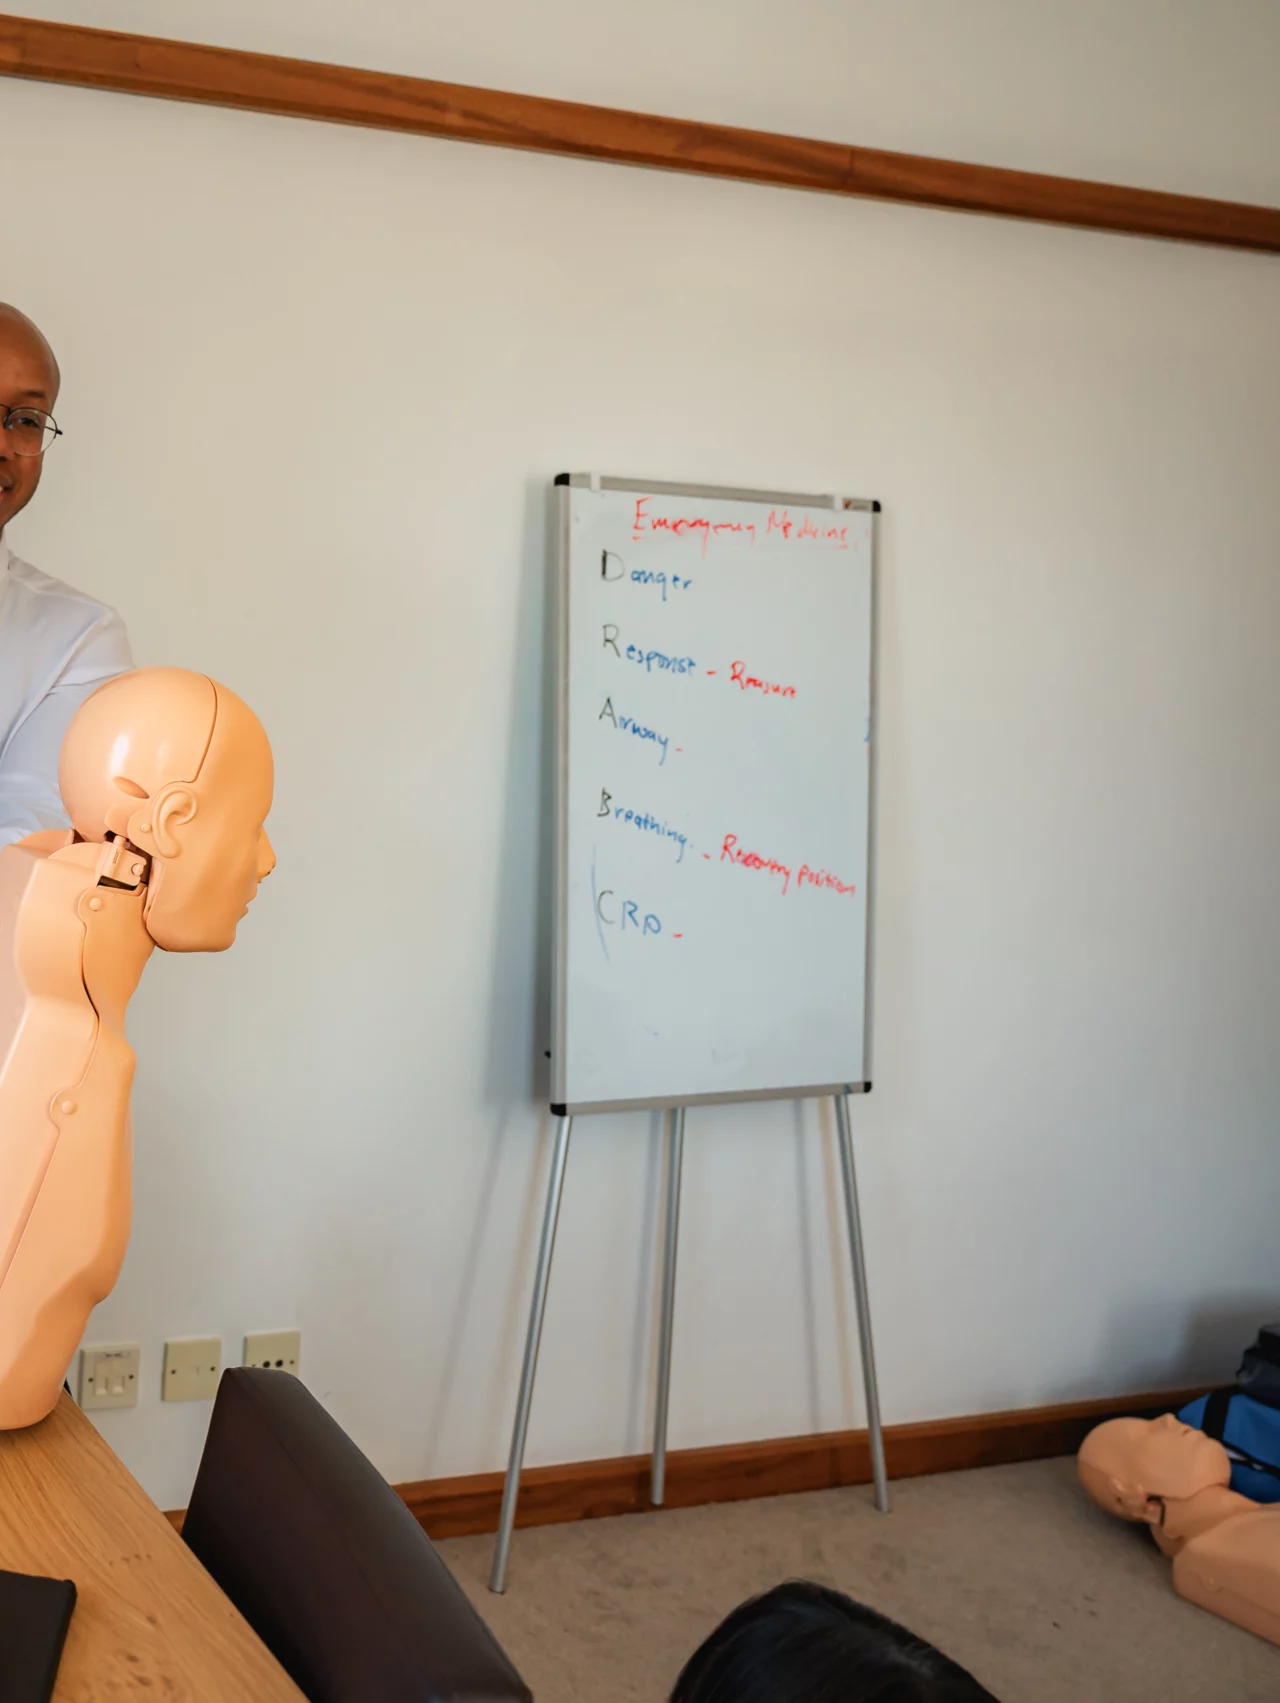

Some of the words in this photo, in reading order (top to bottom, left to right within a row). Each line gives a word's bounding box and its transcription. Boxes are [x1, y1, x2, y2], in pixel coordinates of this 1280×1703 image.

[600, 549, 693, 602] Danger
[601, 624, 697, 676] Response
[596, 787, 687, 864] Breathing
